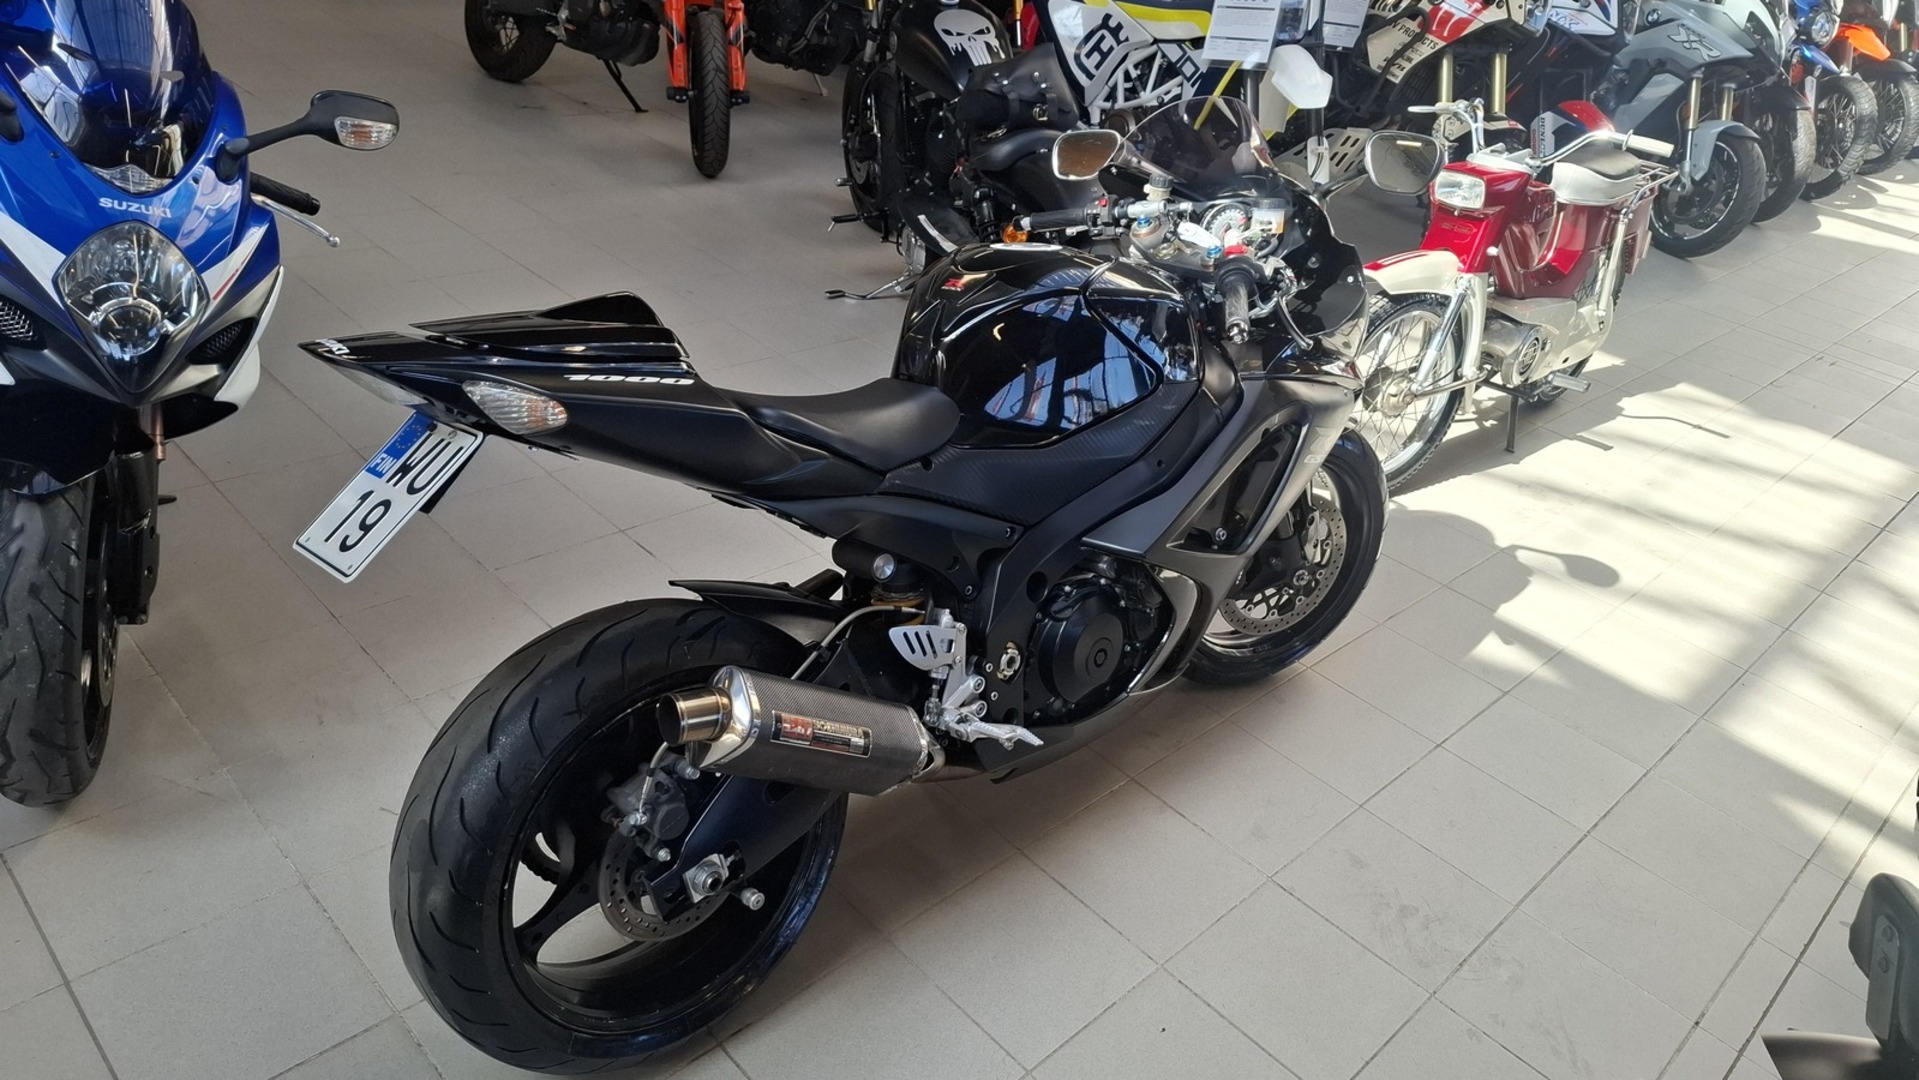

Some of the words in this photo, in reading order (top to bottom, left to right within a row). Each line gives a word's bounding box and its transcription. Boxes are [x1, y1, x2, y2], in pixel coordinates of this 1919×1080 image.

[1398, 24, 1438, 50] PROCTS
[1668, 26, 1721, 61] XR
[98, 197, 172, 218] SUZUKI
[563, 374, 695, 385] 1000
[370, 453, 397, 474] FIN
[385, 433, 465, 495] WU
[323, 490, 392, 552] 19
